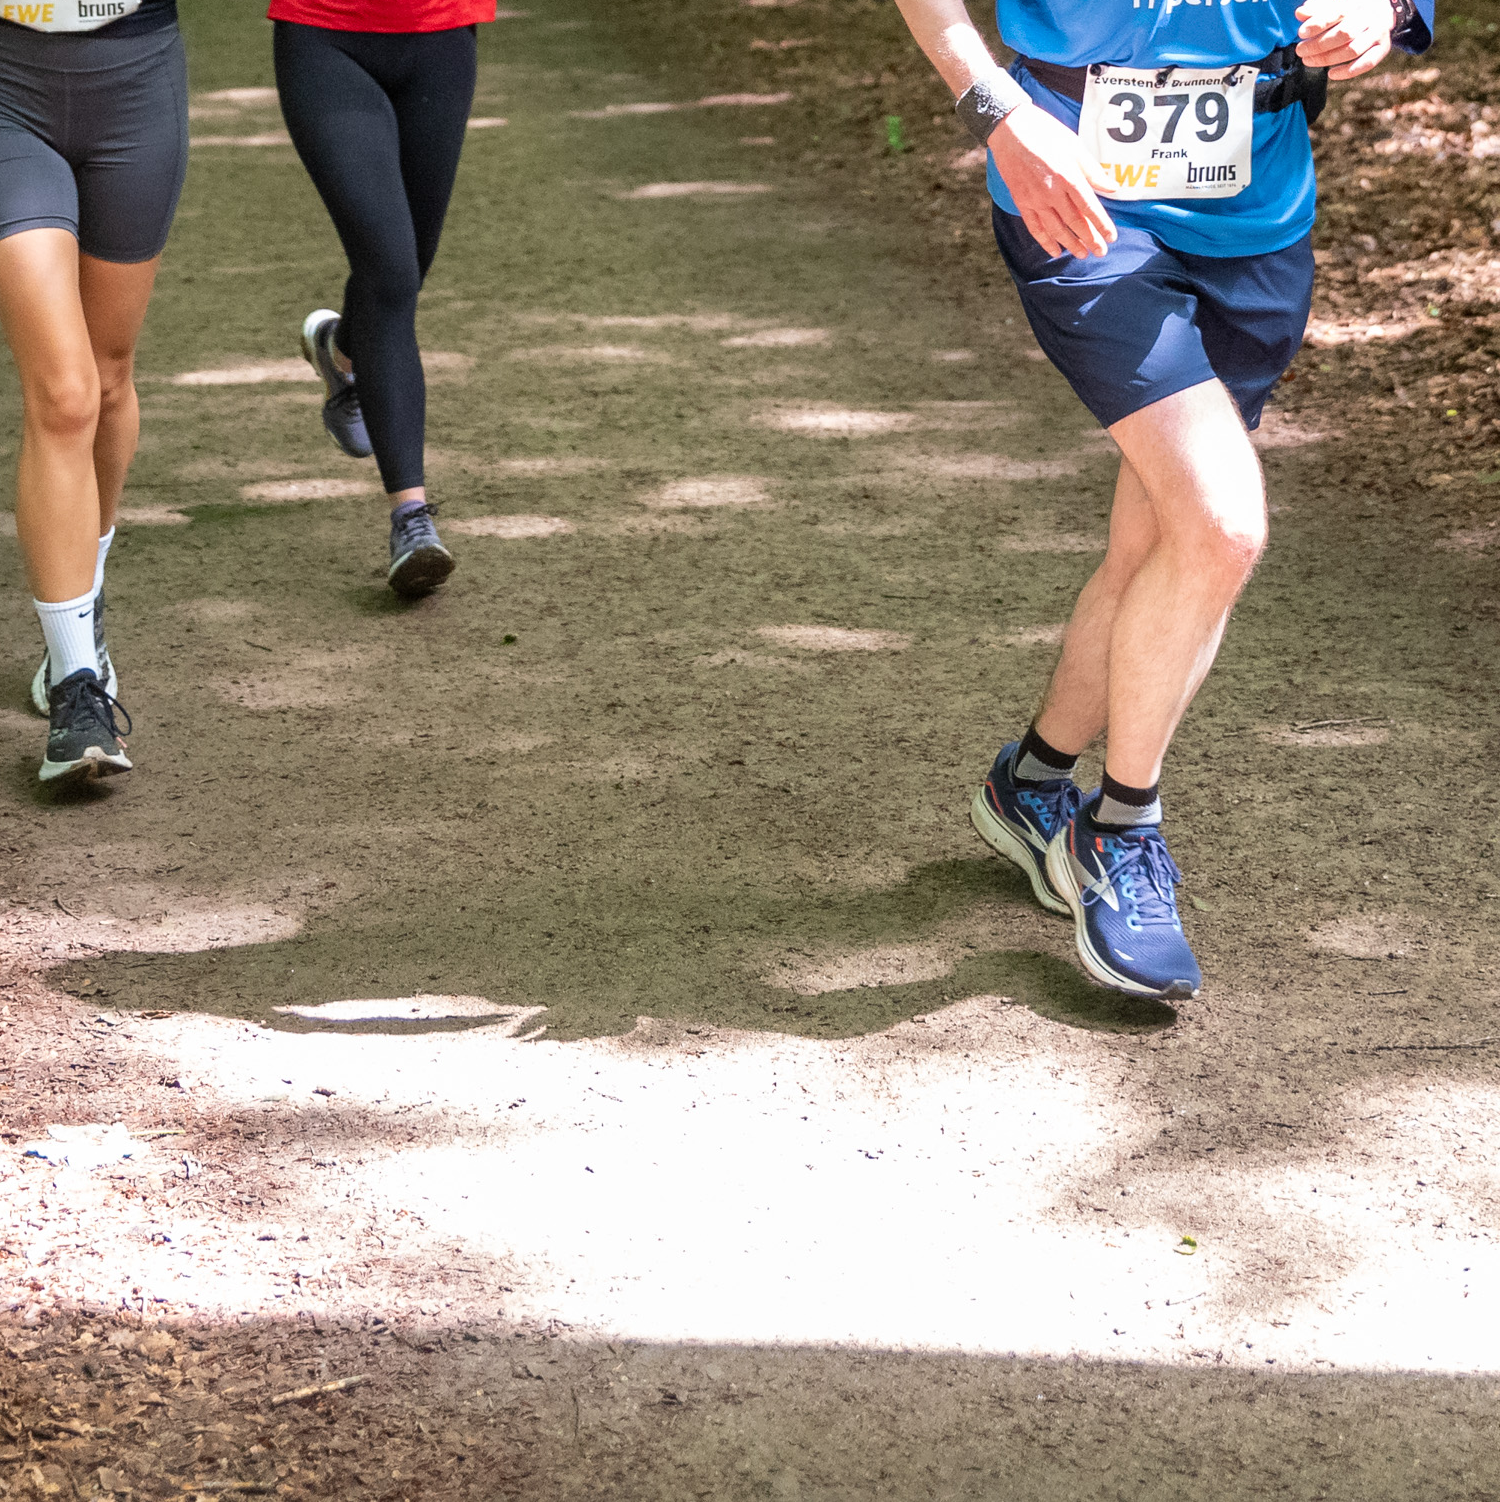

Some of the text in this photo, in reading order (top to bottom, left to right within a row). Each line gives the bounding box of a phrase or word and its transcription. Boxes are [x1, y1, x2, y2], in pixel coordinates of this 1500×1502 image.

[3, 3, 55, 24] EWE
[77, 0, 126, 19] bruns
[1106, 91, 1230, 144] 379
[1151, 148, 1188, 159] Frank
[1187, 161, 1237, 183] bruns
